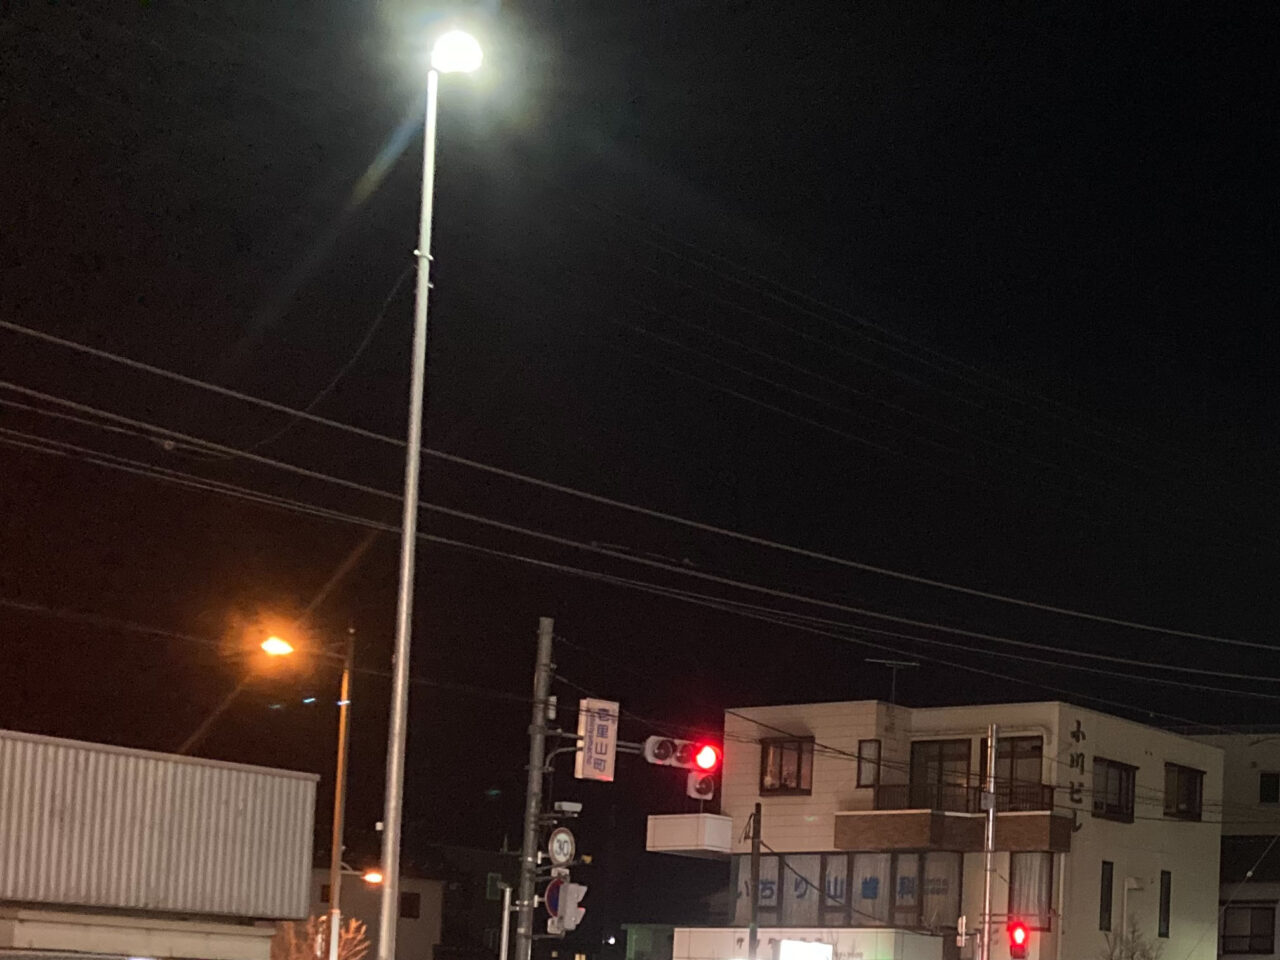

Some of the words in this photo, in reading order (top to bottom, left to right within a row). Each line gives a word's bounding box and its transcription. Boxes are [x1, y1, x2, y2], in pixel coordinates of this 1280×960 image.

[555, 839, 569, 857] 30
[736, 876, 916, 900] いちり山歯科
